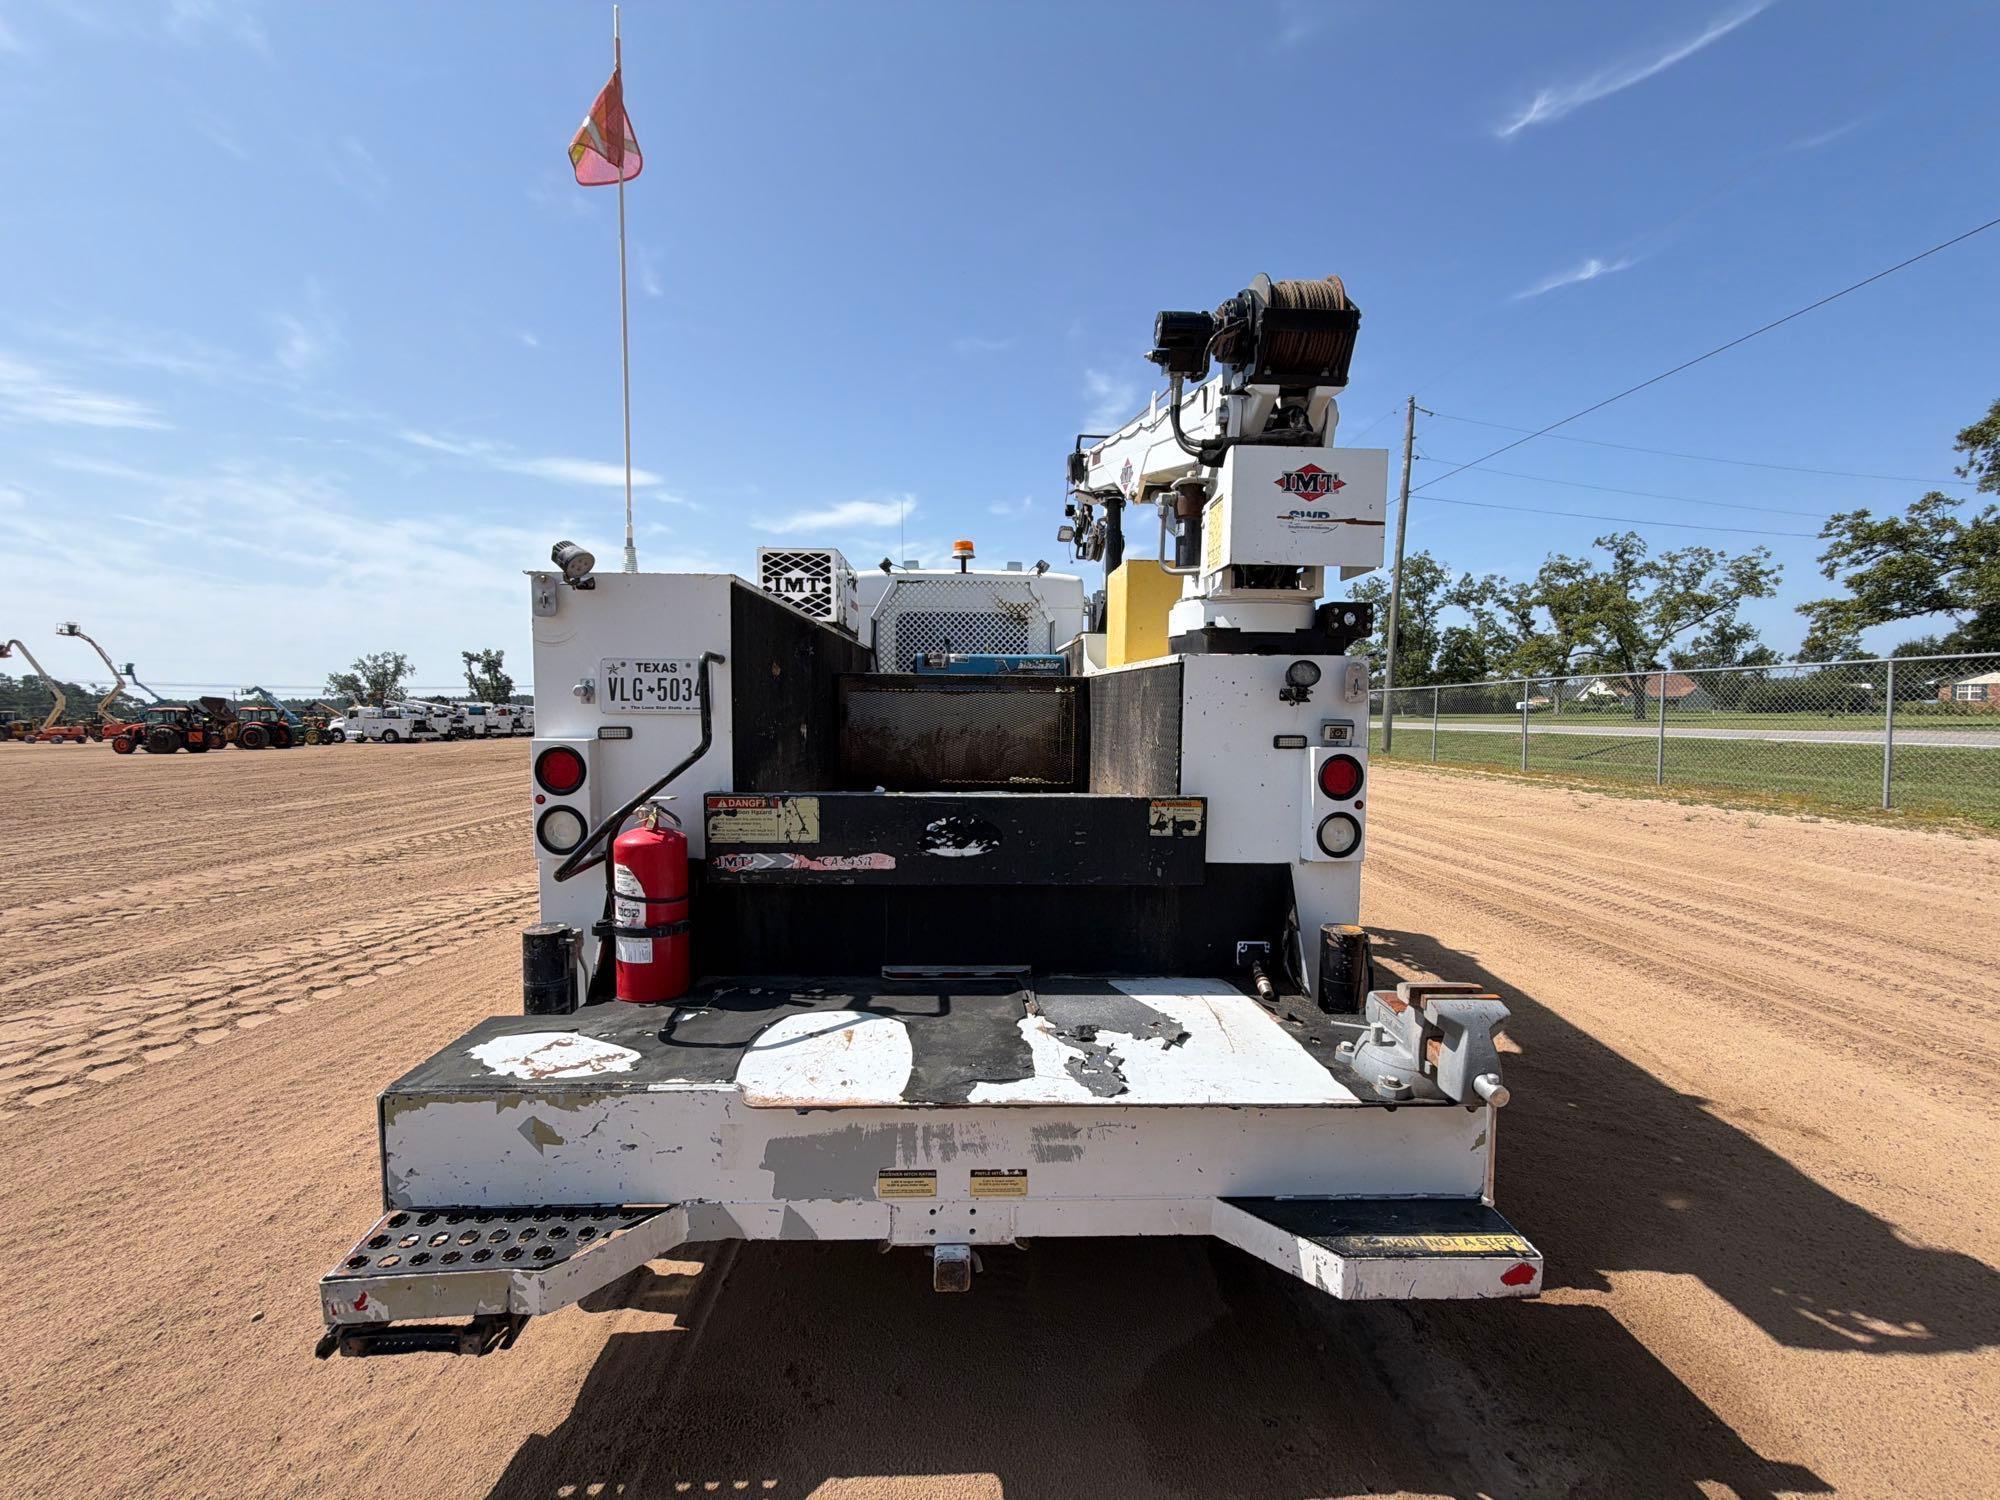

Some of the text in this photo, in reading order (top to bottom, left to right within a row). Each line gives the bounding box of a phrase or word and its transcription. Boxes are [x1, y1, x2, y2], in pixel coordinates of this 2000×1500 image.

[1283, 472, 1339, 493] IMT
[773, 577, 820, 593] IMT
[635, 662, 678, 673] TEXAS
[608, 677, 643, 702] VLG
[1428, 1237, 1461, 1247] NOT
[1464, 1237, 1476, 1246] A
[1479, 1235, 1523, 1247] STEP!
